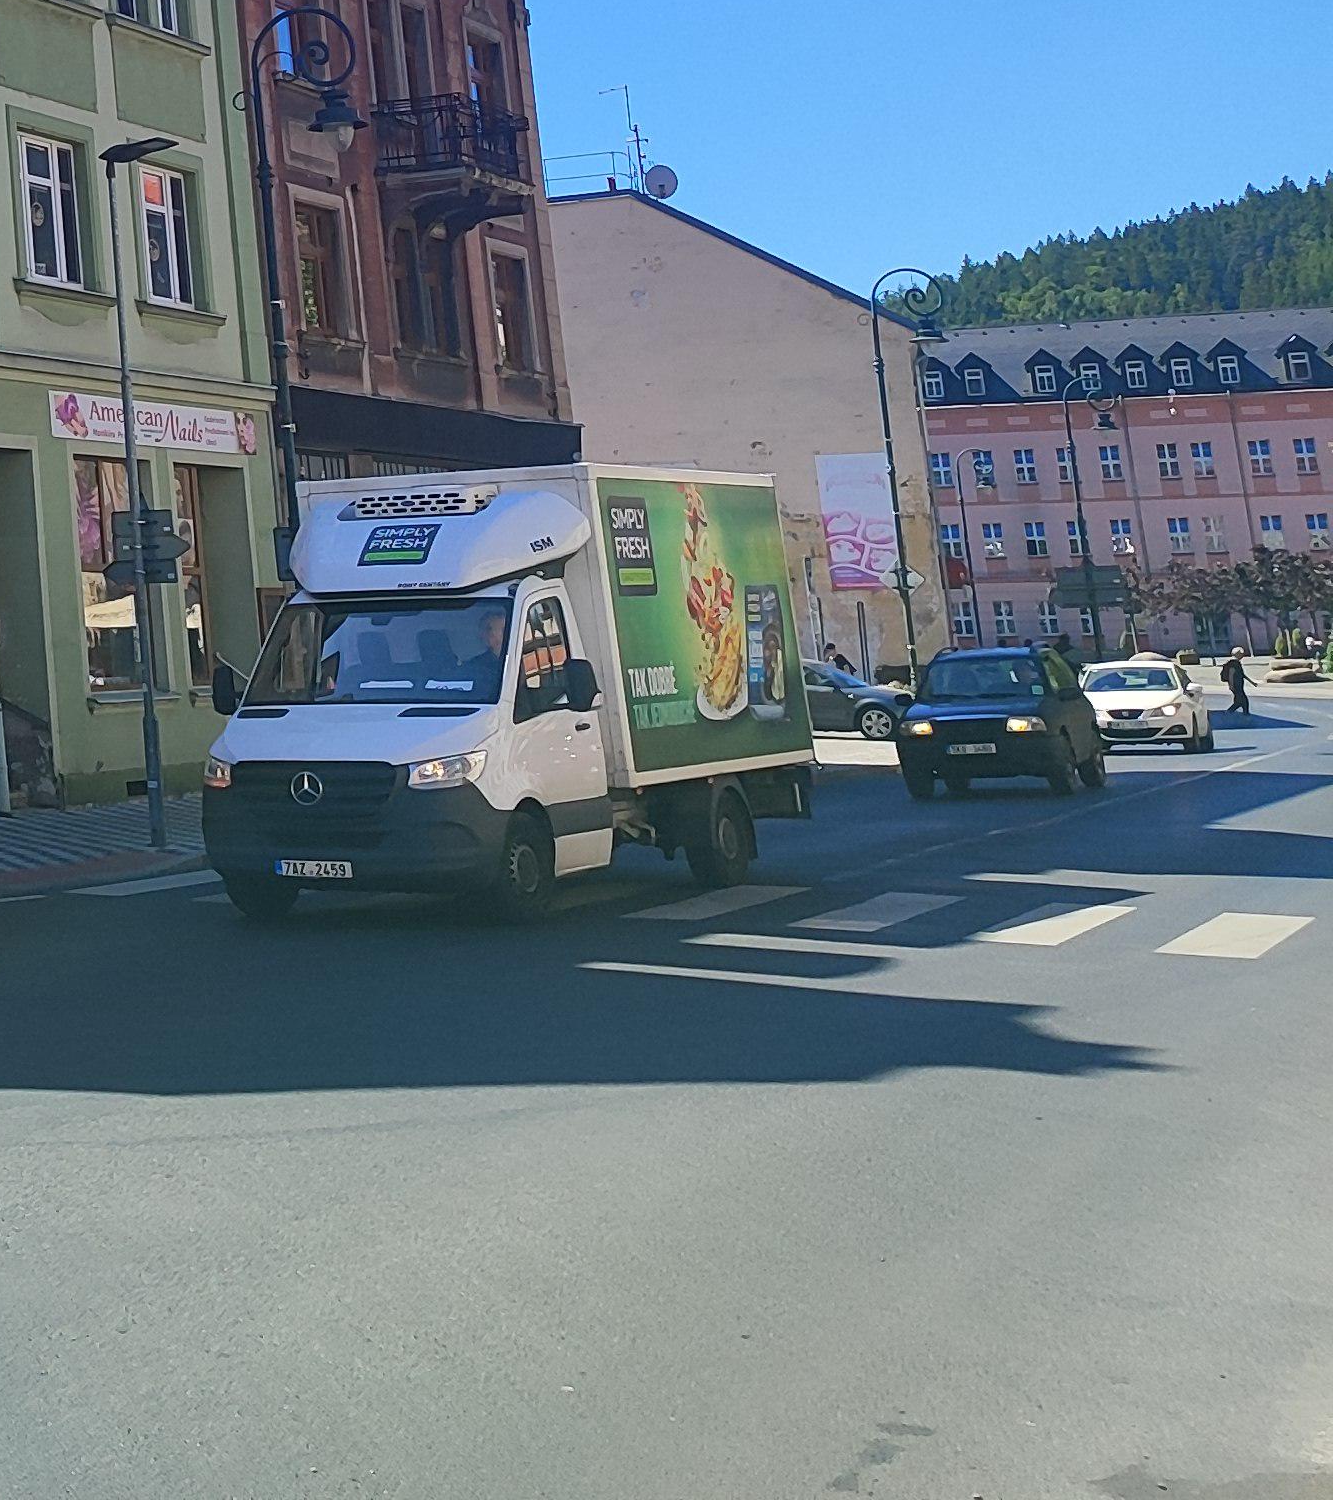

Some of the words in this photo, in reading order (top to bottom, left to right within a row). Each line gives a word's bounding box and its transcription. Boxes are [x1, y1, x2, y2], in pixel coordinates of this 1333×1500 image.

[89, 401, 163, 427] Amecan
[155, 410, 203, 442] Nails
[611, 508, 645, 530] SIMPLY
[368, 537, 429, 550] FRESH
[374, 527, 435, 539] SIMPLY
[614, 536, 651, 559] FRESH
[628, 668, 649, 698] TAK
[284, 861, 306, 875] 7AZ
[315, 863, 347, 877] 2459
